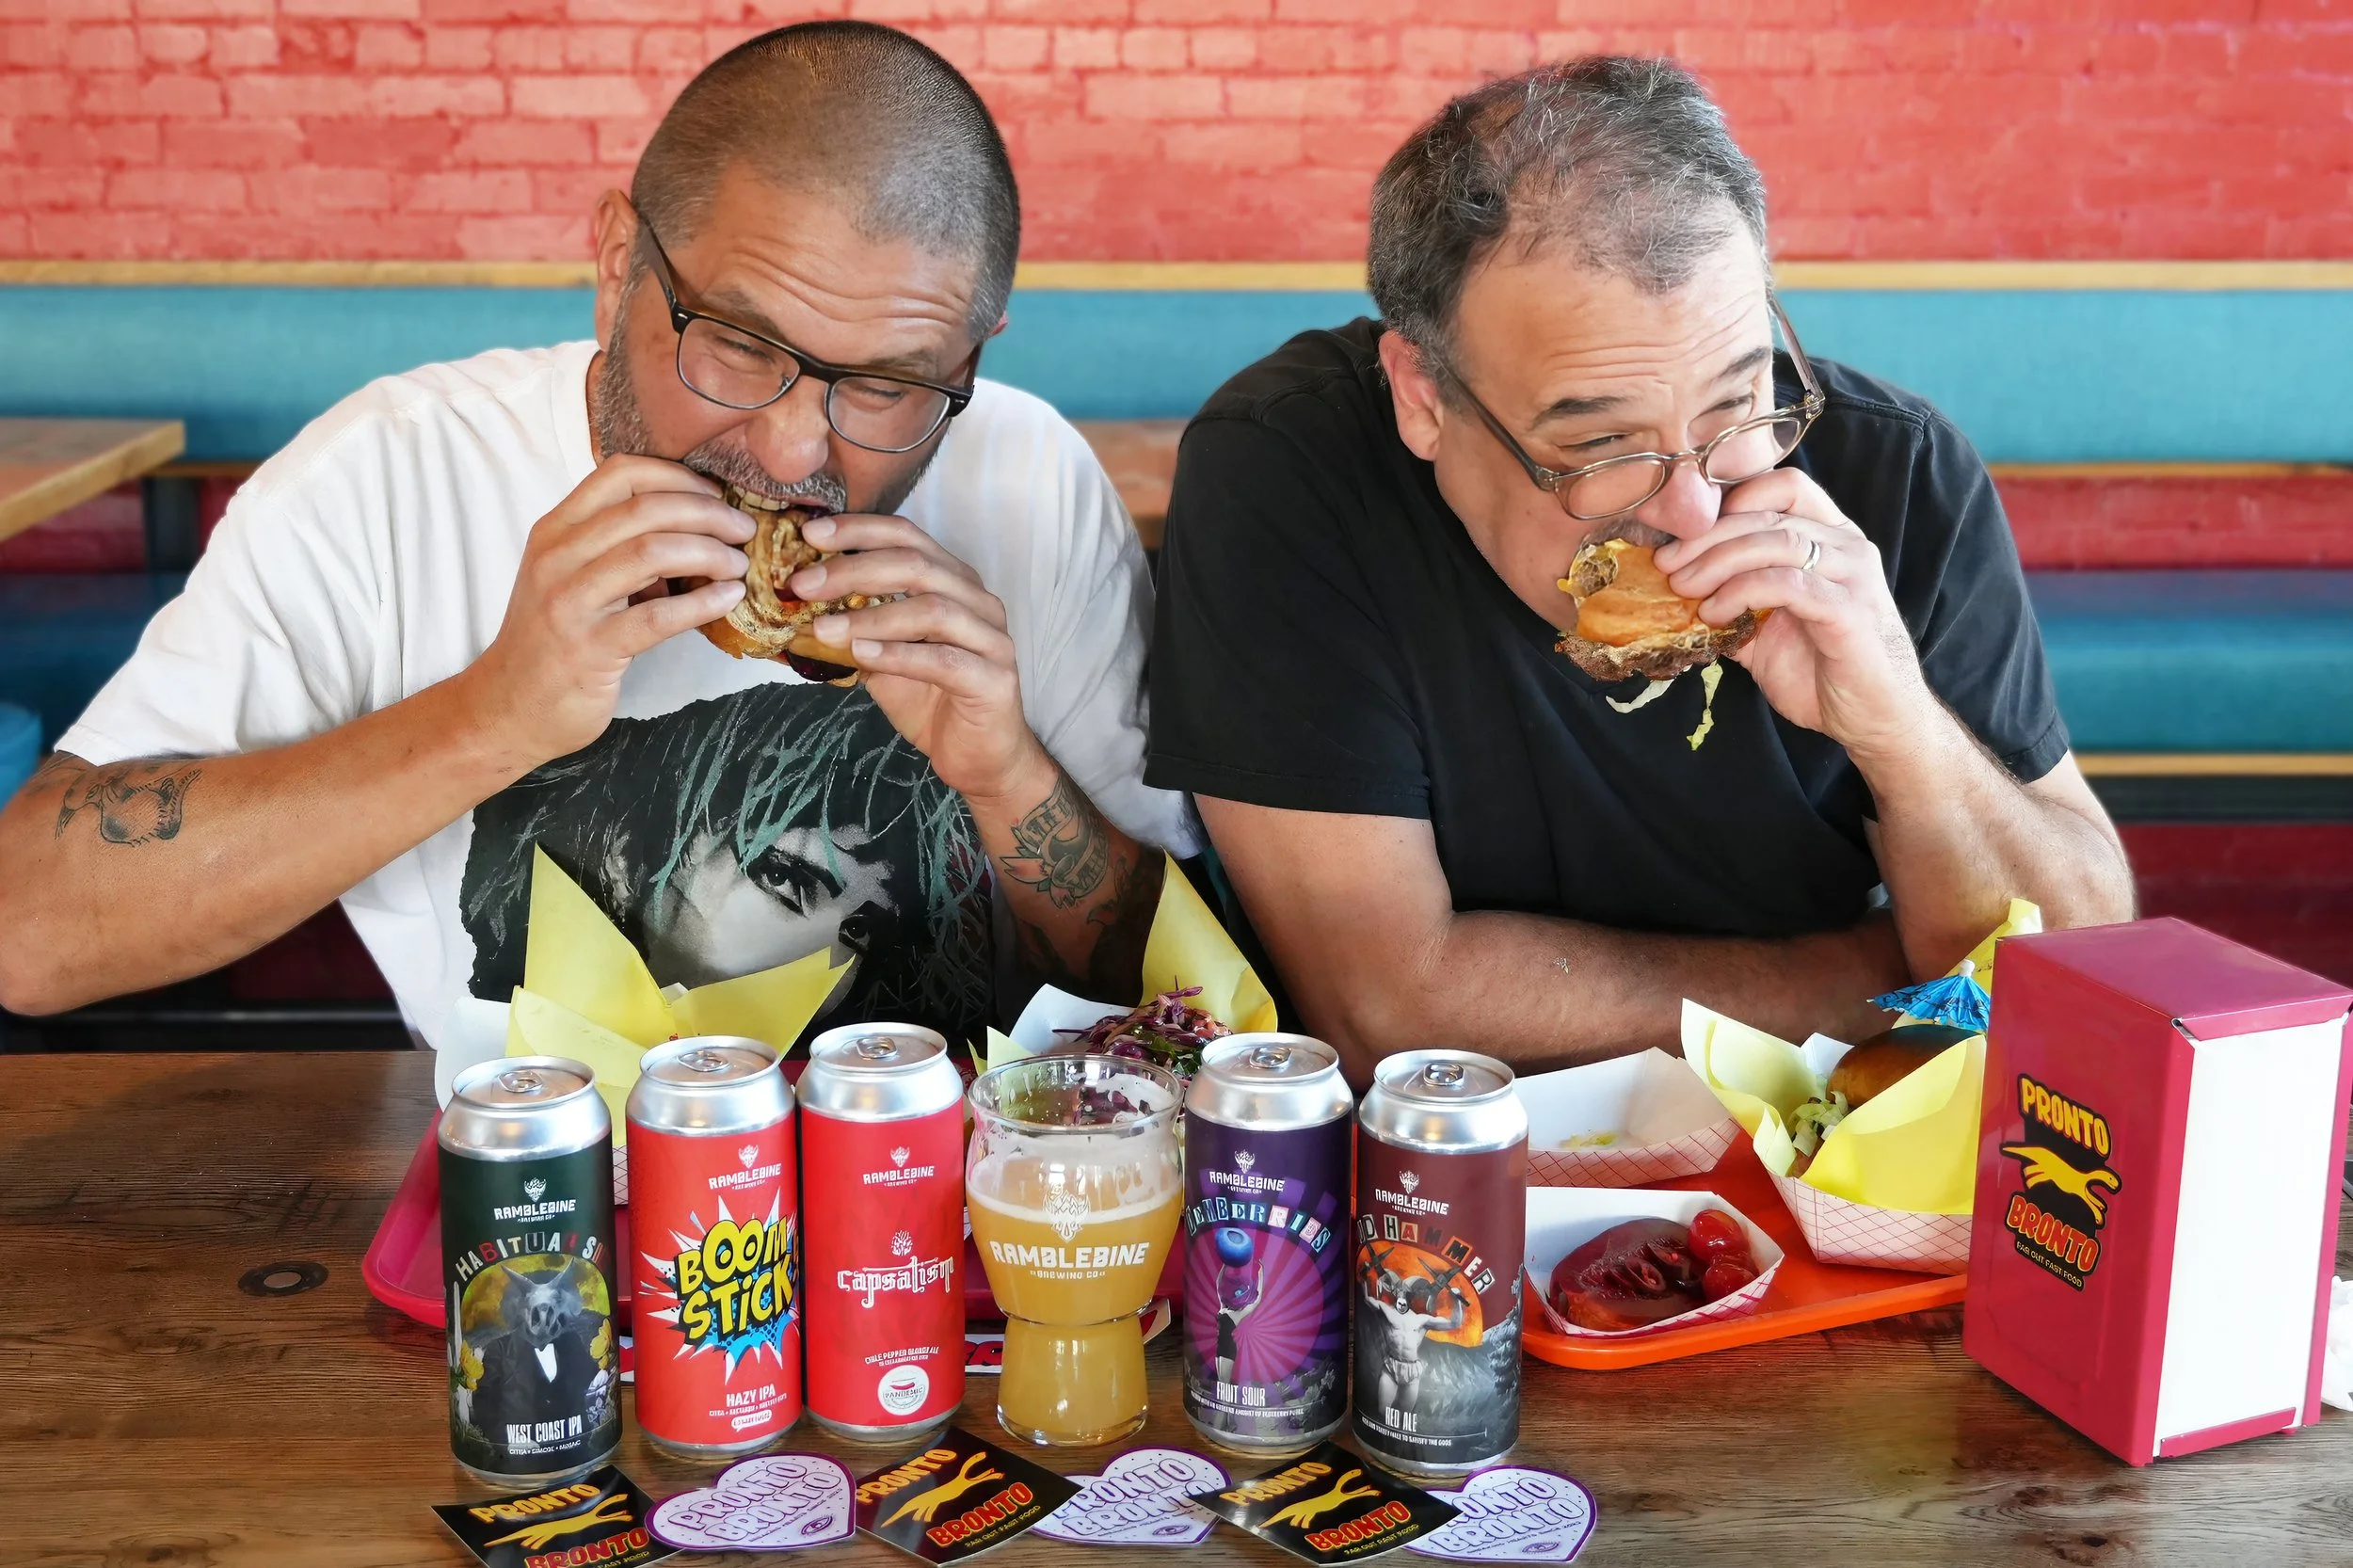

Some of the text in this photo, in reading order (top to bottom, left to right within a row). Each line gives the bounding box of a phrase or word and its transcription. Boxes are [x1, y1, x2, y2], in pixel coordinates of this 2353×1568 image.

[2021, 1077, 2110, 1156] PRONTO
[708, 1162, 782, 1190] RAMBLEBINE
[863, 1165, 936, 1185] RAMBLEBINE
[1209, 1171, 1286, 1192] RAMBLEBINE
[494, 1199, 577, 1221] RAMBLEBINE
[1375, 1188, 1449, 1215] RAMBLEBINE
[2006, 1194, 2099, 1272] BRONTO
[677, 1215, 788, 1296] BOOM
[989, 1240, 1150, 1269] RAMBLEBINE
[1384, 1214, 1496, 1294] HAMMER
[2030, 1250, 2044, 1264] OUT
[2044, 1259, 2063, 1275] FAST
[2063, 1270, 2083, 1288] FOOD
[1037, 1271, 1082, 1280] BREWING
[883, 1349, 906, 1360] PEPPER
[726, 1388, 757, 1407] HAZY
[759, 1383, 776, 1400] IPA
[1216, 1381, 1239, 1403] FRUIT
[1241, 1386, 1266, 1407] SOUR
[506, 1414, 583, 1444] WEST COAST IPA
[1385, 1406, 1400, 1429] RED
[1402, 1411, 1417, 1432] ALE
[667, 1462, 808, 1531] PRONTO
[856, 1448, 958, 1505] PRONTO
[1052, 1458, 1196, 1519] RONTO
[1219, 1462, 1334, 1507] PRONTO
[468, 1483, 601, 1525] PRONTO
[703, 1471, 841, 1542] BRONTO
[925, 1481, 1034, 1548] BRONTO
[1446, 1477, 1558, 1528] ONTO
[1304, 1499, 1412, 1552] BRONTO
[1428, 1496, 1585, 1553] BRONTO
[523, 1527, 650, 1568] BRONTO
